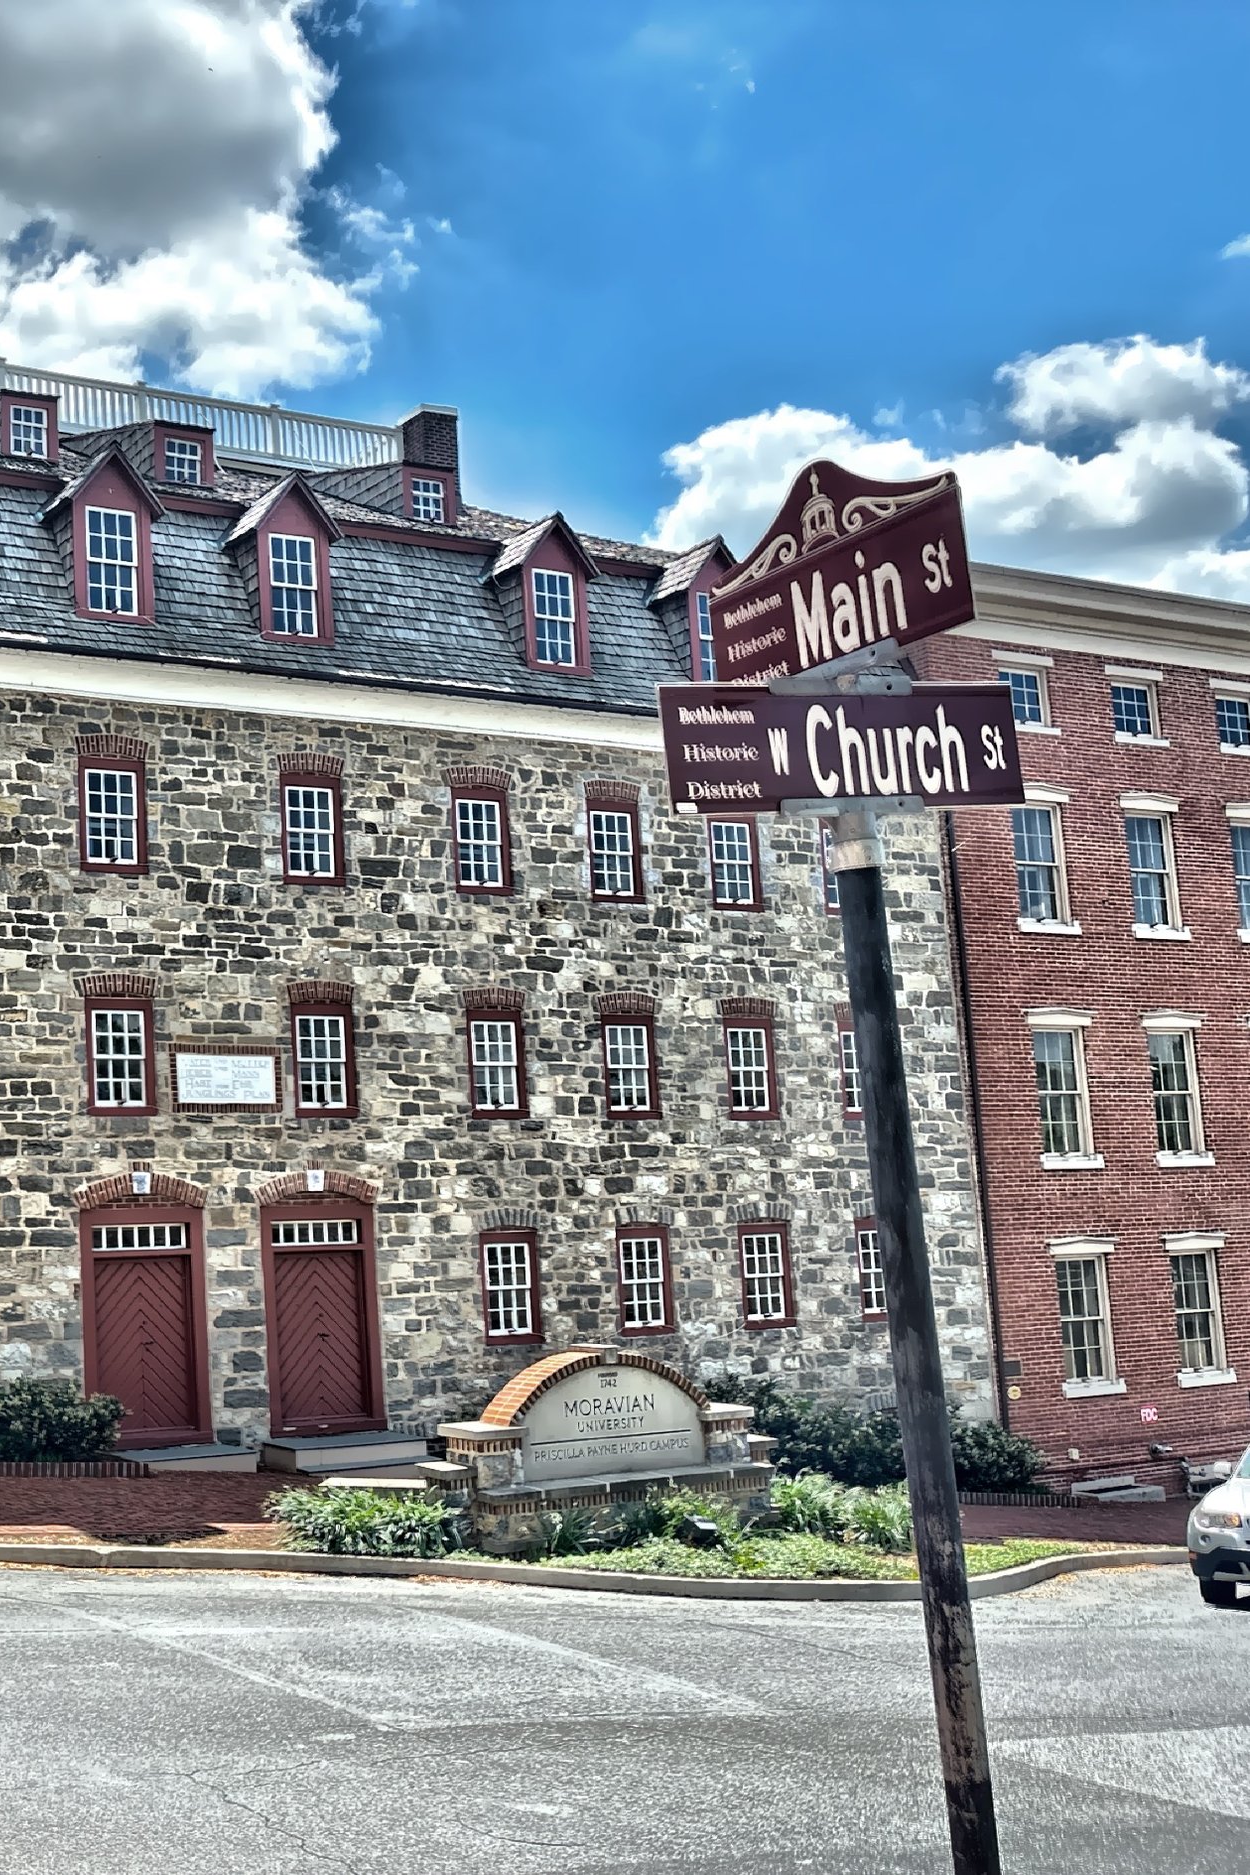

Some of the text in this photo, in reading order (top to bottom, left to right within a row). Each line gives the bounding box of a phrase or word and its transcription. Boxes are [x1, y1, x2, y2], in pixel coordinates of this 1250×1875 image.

[723, 593, 783, 630] Bethlehem
[790, 535, 954, 669] Main St
[727, 626, 787, 663] Historic
[678, 705, 755, 725] Bethlehem
[682, 742, 760, 762] Historic
[767, 703, 1007, 798] W Church St
[686, 780, 763, 800] District
[564, 1394, 655, 1417] MORAVIAN
[1140, 1407, 1158, 1422] FDC
[577, 1416, 644, 1433] UNIVERSITY
[534, 1438, 689, 1462] PRISCILLA PAYNE HURD CAMPUS
